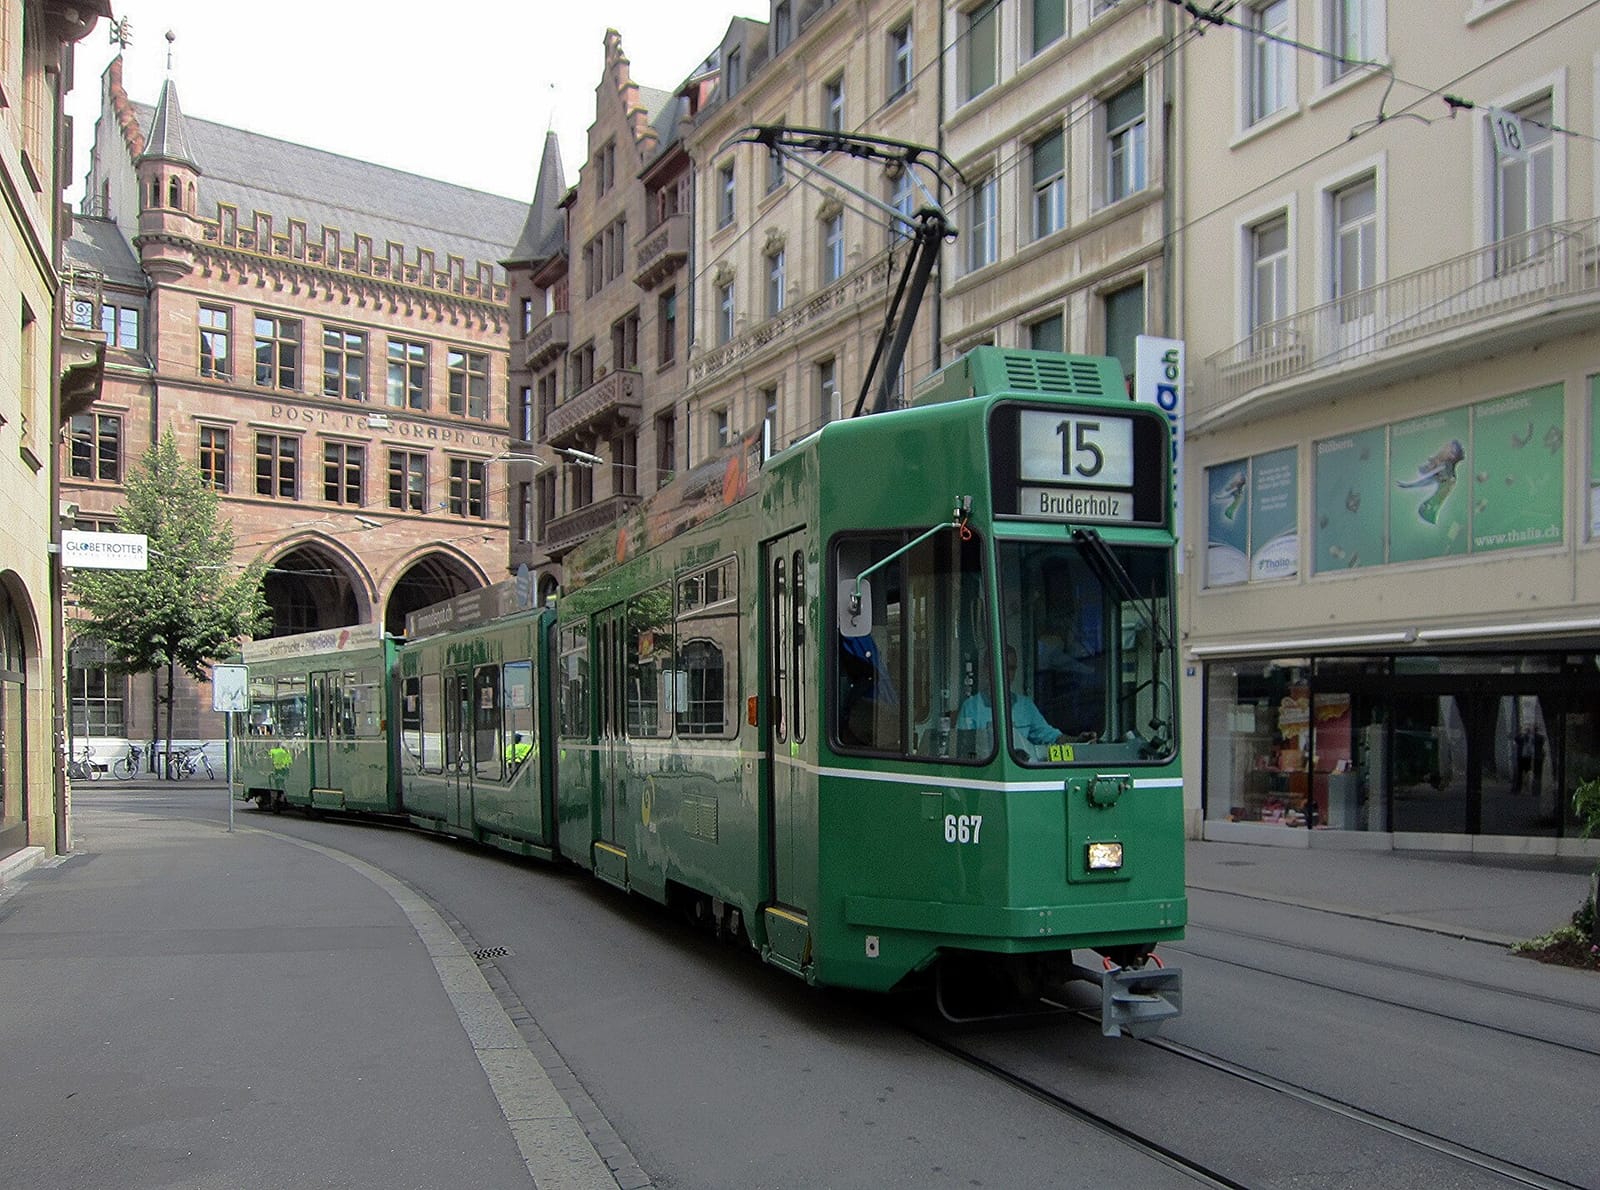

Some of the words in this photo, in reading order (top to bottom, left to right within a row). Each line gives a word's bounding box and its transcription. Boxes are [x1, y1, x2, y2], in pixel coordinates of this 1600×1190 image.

[1498, 117, 1521, 150] 18
[342, 413, 465, 443] TEEGRAPH
[1056, 420, 1104, 477] 15
[1040, 492, 1119, 516] Bruderholz
[66, 541, 143, 554] GLOBETROTTER
[1474, 524, 1560, 546] www.thalia.ch
[944, 814, 983, 844] 667
